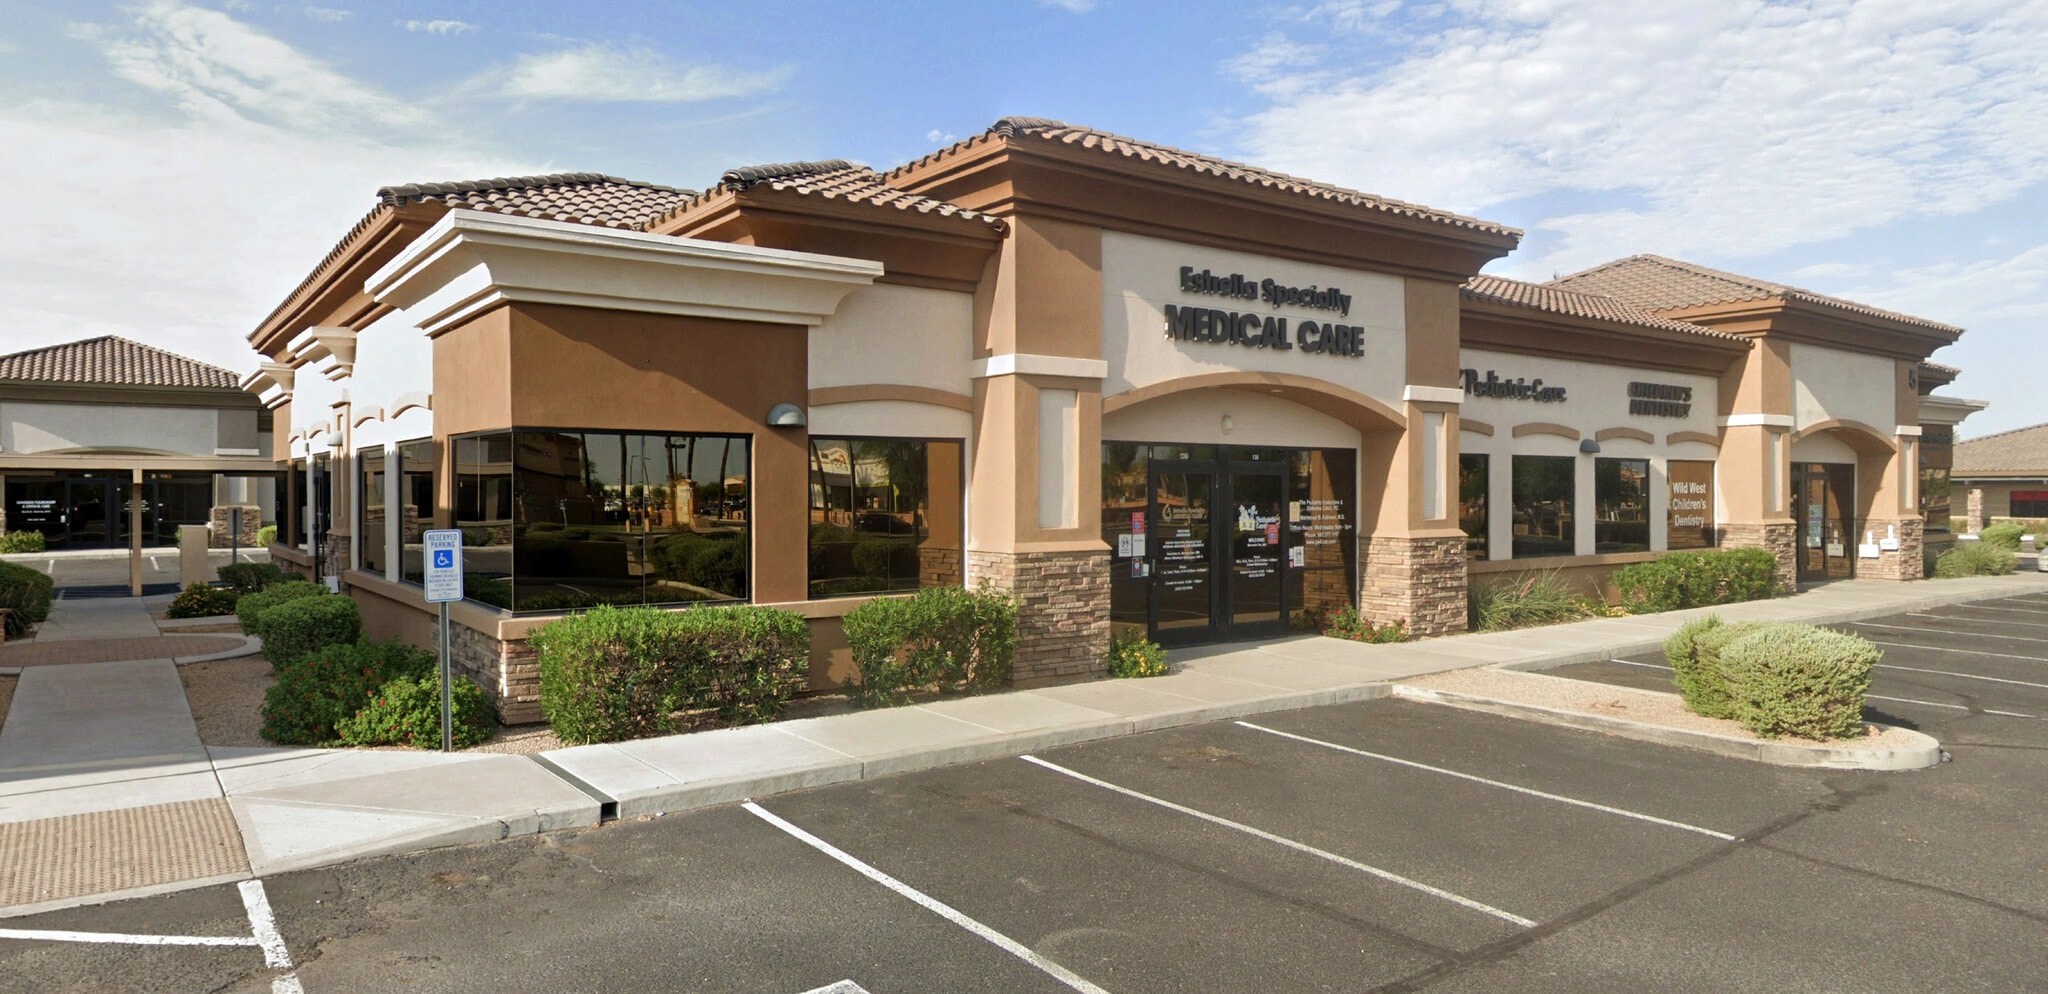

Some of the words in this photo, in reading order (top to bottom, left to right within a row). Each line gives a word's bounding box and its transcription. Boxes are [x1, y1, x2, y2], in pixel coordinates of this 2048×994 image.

[1180, 266, 1258, 299] Estrella
[1261, 278, 1352, 317] Specialty
[1164, 304, 1293, 350] MEDICAL
[1298, 320, 1365, 357] CARE
[1465, 368, 1531, 399] Pediatric
[1532, 378, 1567, 402] Care
[1629, 399, 1692, 419] DENTISTRY
[1672, 482, 1688, 494] Wild
[1689, 482, 1706, 494] West
[1672, 498, 1707, 510] Children's
[1674, 514, 1704, 528] Dentistry
